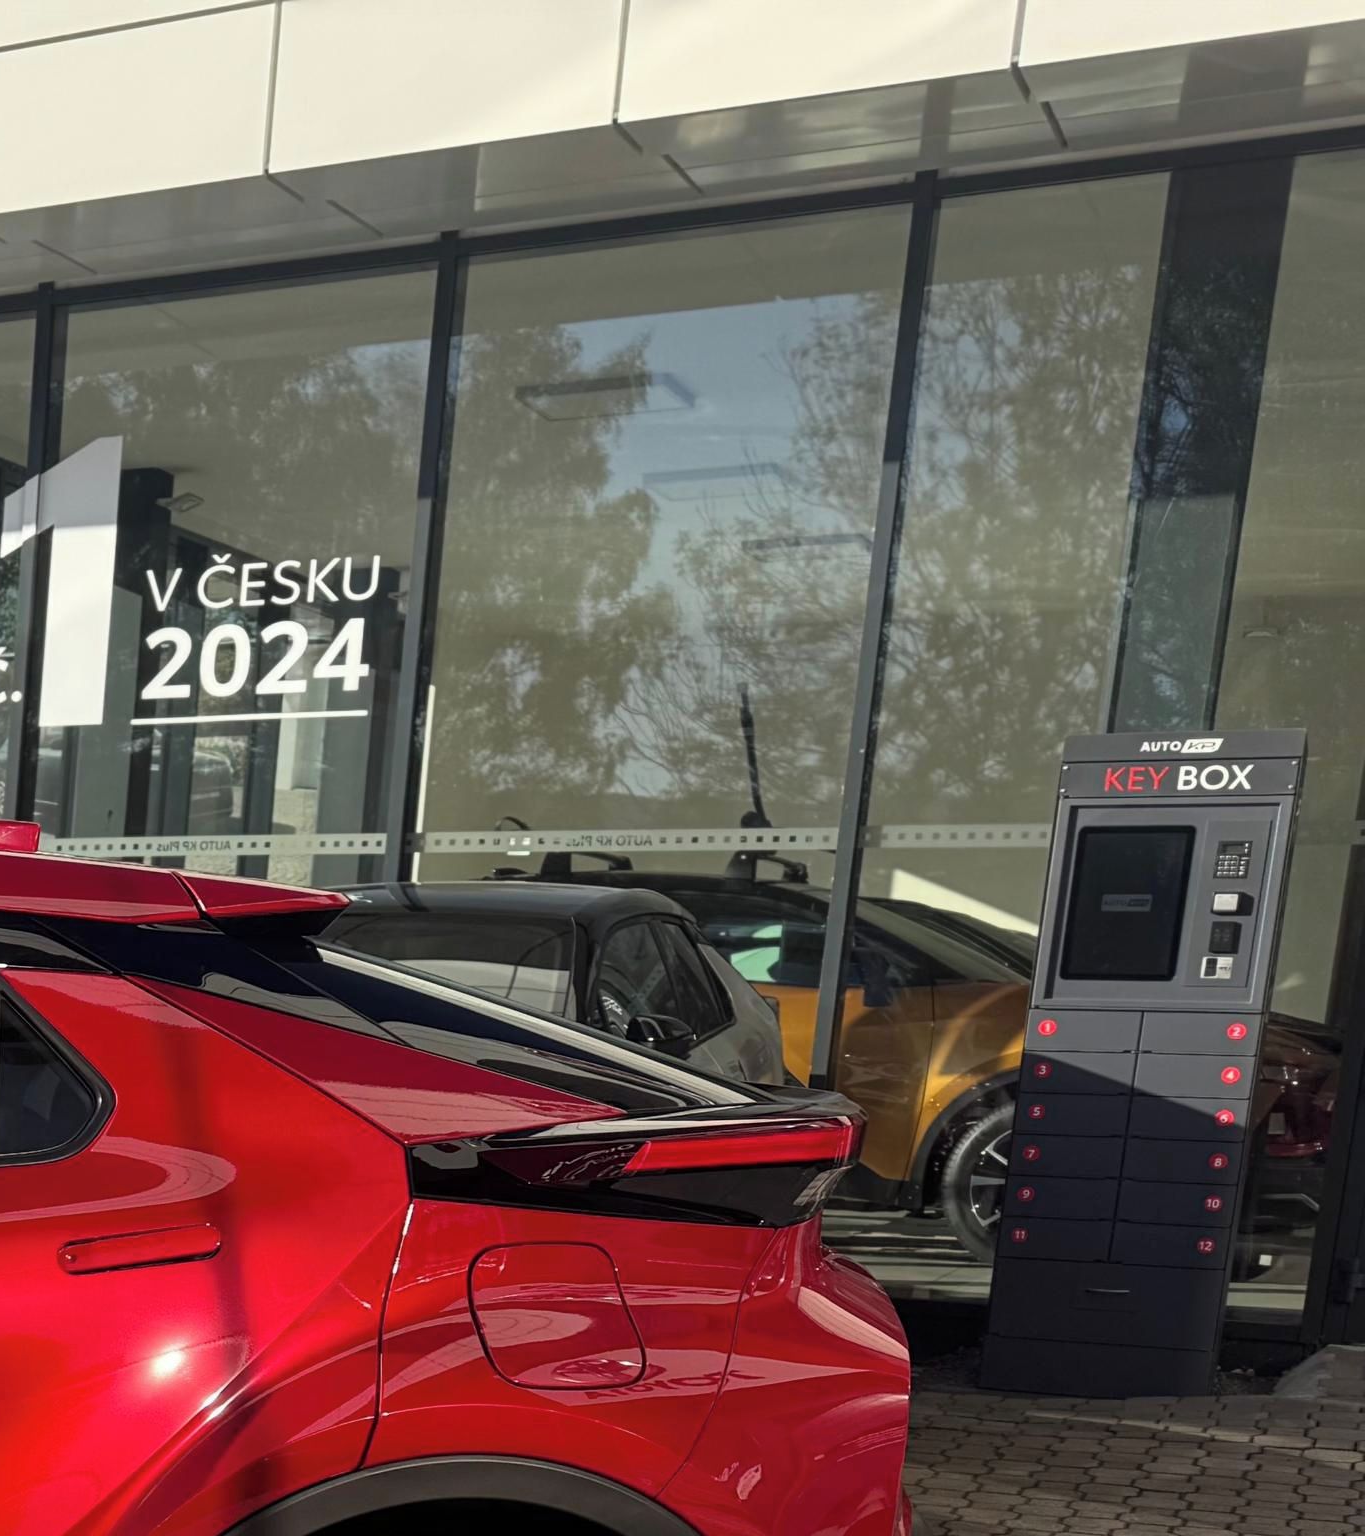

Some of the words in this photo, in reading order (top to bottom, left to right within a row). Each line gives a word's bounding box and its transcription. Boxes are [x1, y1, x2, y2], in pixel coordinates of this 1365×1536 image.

[0, 435, 123, 727] 1
[146, 567, 183, 612] V
[197, 553, 381, 610] ČESKU
[141, 617, 369, 700] 2024
[1140, 741, 1182, 752] AUTO
[1103, 766, 1170, 792] KEY
[1177, 764, 1254, 791] BOX
[1232, 1027, 1241, 1036] 2
[1038, 1065, 1047, 1075] 3
[1226, 1070, 1235, 1080] 4
[1032, 1107, 1041, 1116] 5
[1220, 1113, 1228, 1123] 6
[1028, 1150, 1036, 1158] 7
[1214, 1158, 1222, 1167] 8
[1023, 1190, 1030, 1199] 9
[1206, 1198, 1220, 1208] 10
[1014, 1230, 1026, 1239] 11
[1198, 1241, 1212, 1251] 12
